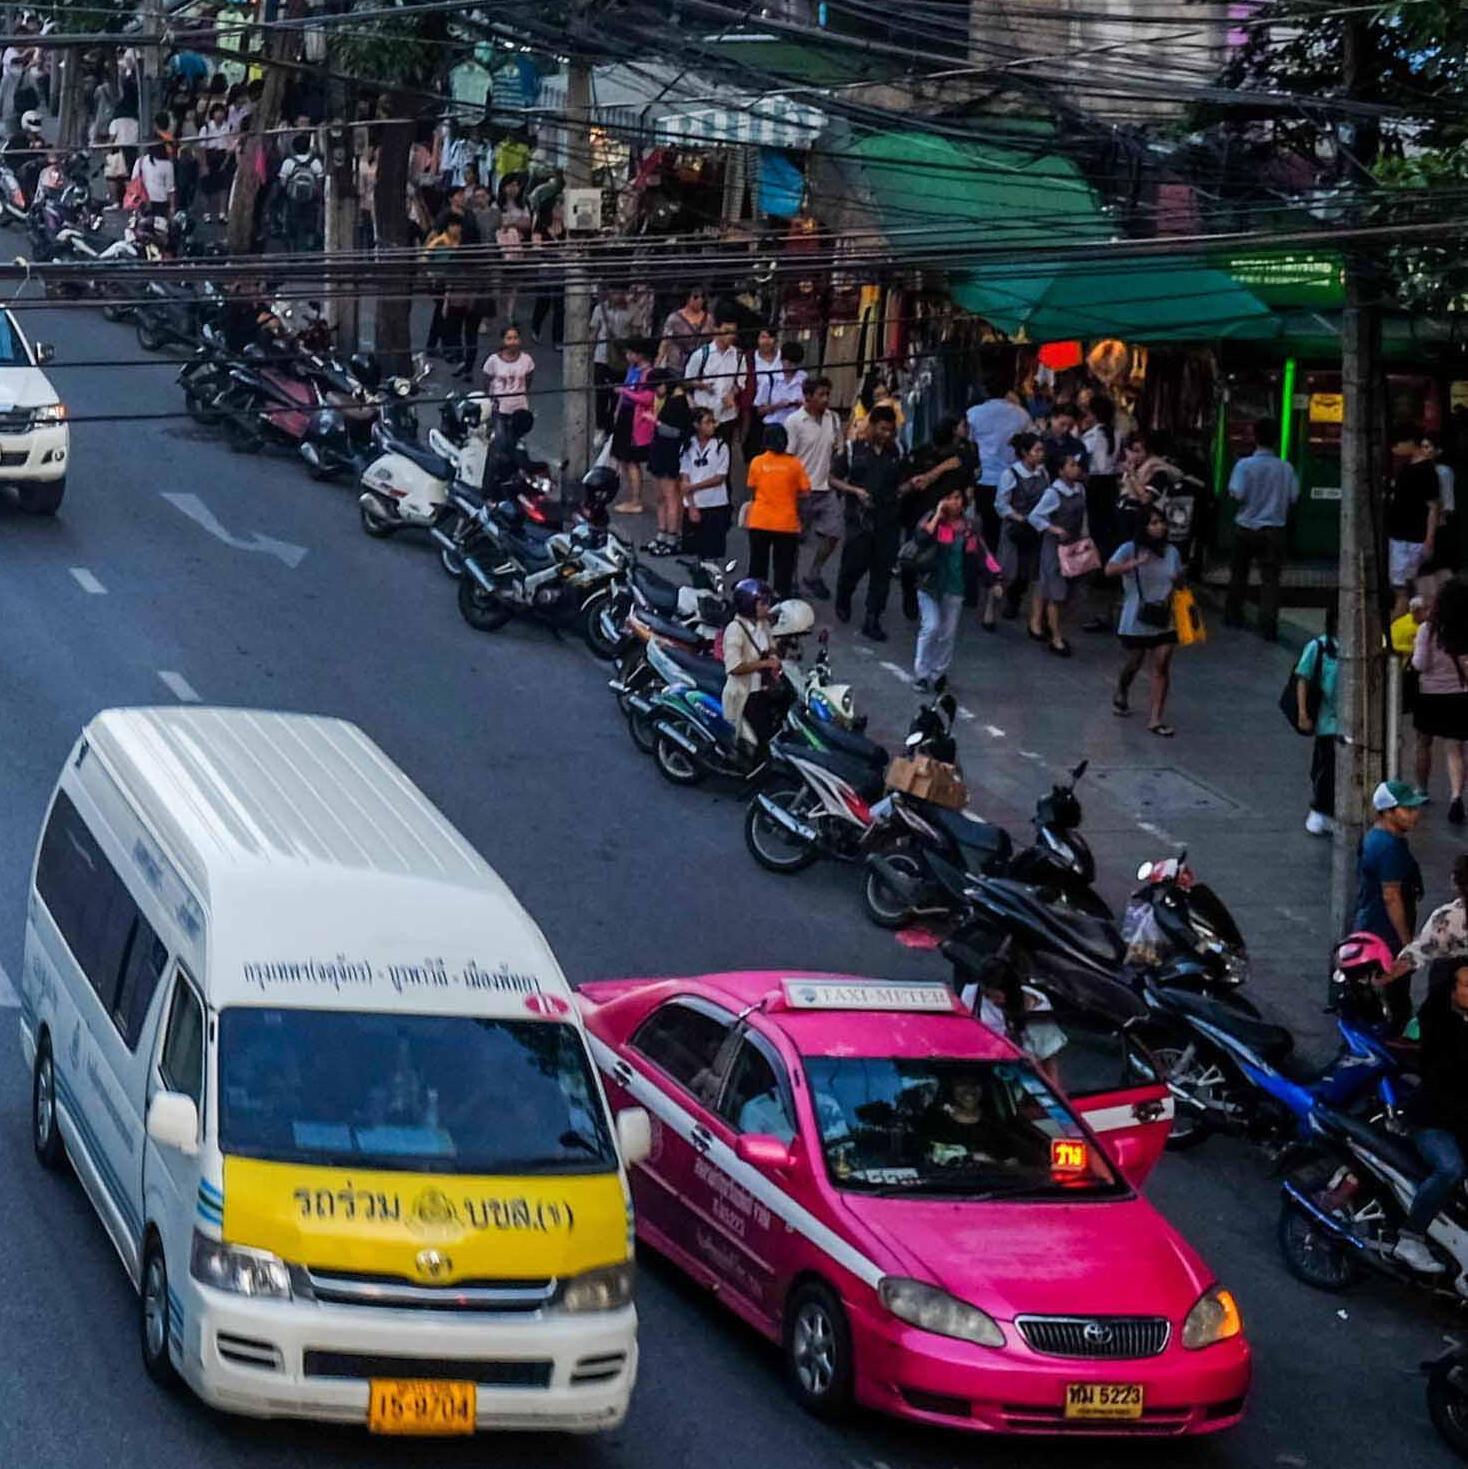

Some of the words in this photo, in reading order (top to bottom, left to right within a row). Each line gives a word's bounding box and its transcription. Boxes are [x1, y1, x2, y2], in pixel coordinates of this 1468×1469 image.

[293, 1181, 402, 1221] รถร่วม
[1099, 1385, 1141, 1405] 5223
